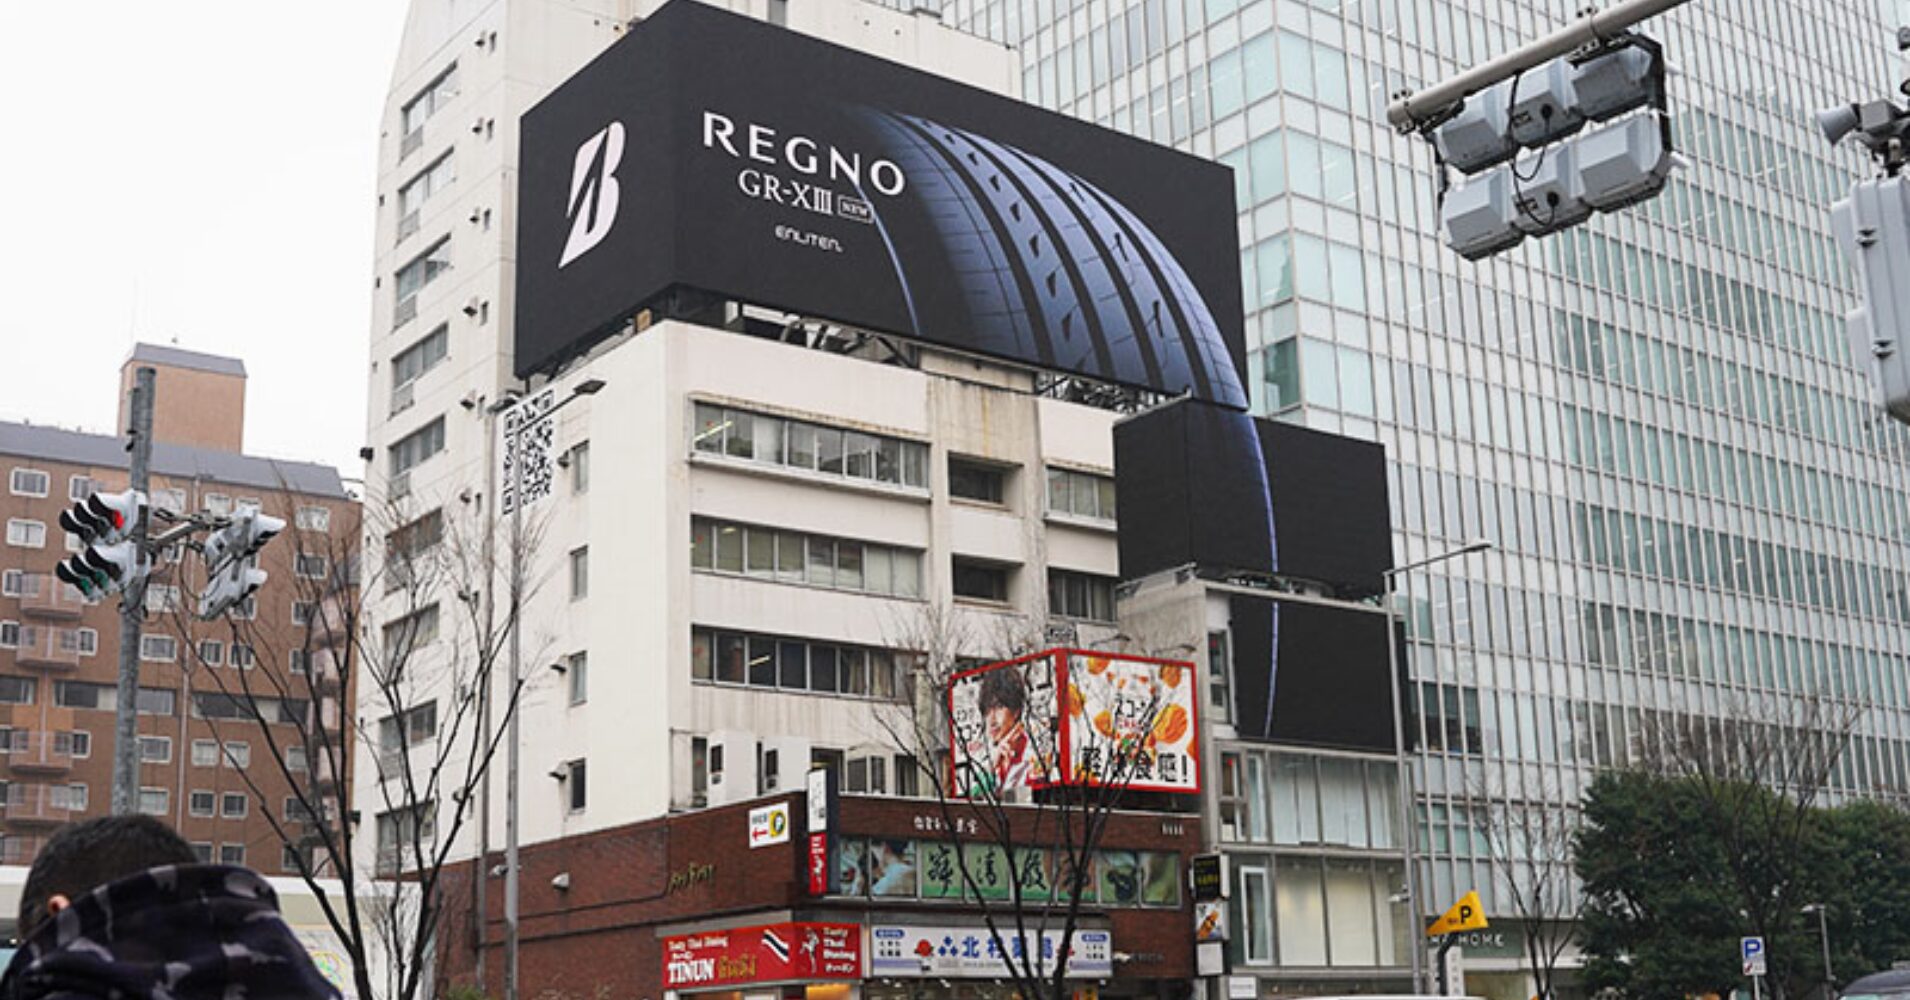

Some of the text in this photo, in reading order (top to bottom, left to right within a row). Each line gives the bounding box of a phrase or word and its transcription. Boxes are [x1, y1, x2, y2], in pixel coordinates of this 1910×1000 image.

[703, 110, 905, 196] REGNO
[1459, 905, 1472, 924] P
[1744, 939, 1760, 959] P
[668, 959, 715, 984] TINUN
